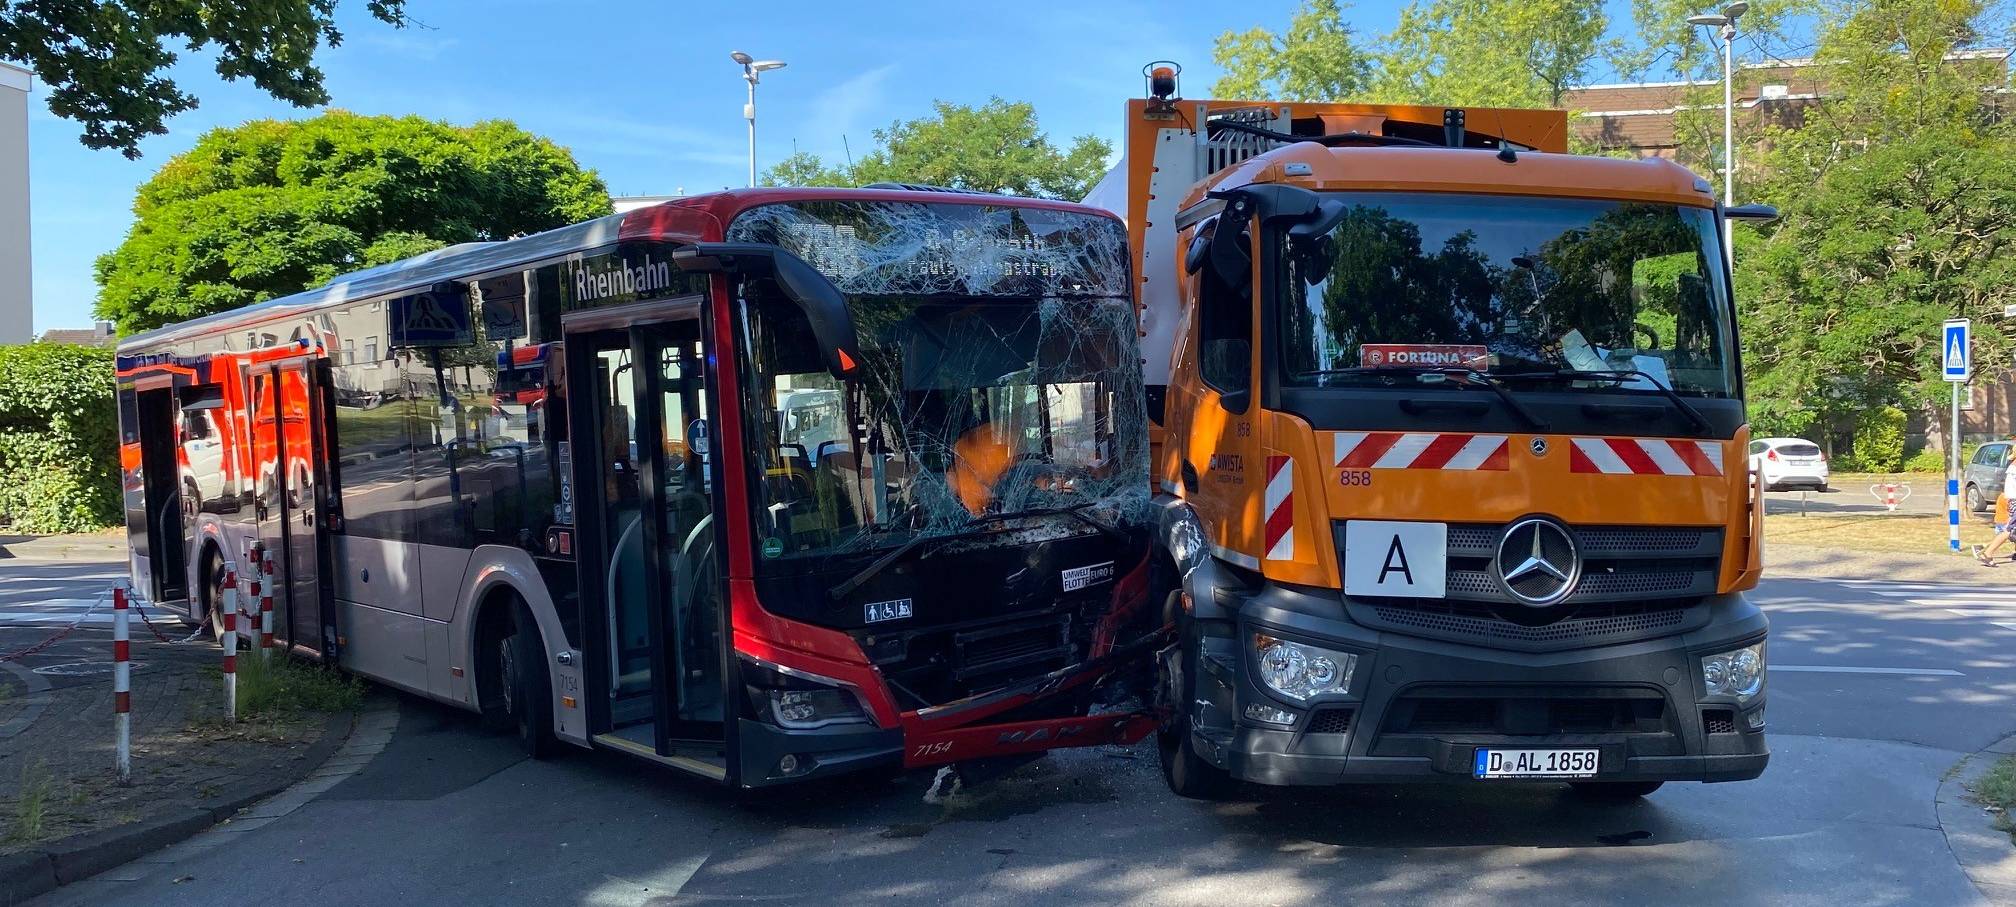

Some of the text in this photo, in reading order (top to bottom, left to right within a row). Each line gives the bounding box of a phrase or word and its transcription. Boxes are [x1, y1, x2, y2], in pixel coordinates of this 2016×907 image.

[575, 253, 670, 301] Rheinbahn
[1388, 351, 1460, 363] FORTUNA
[1237, 422, 1251, 437] 858
[1217, 454, 1244, 472] AWISTA
[1340, 470, 1371, 486] 858
[1377, 533, 1414, 585] A
[1063, 568, 1090, 580] UMWELT
[1090, 565, 1114, 580] EURO 6
[1064, 577, 1090, 591] FLOTTE
[560, 672, 578, 692] 7154
[914, 741, 953, 757] 7154
[1489, 752, 1596, 771] D AL 1858
